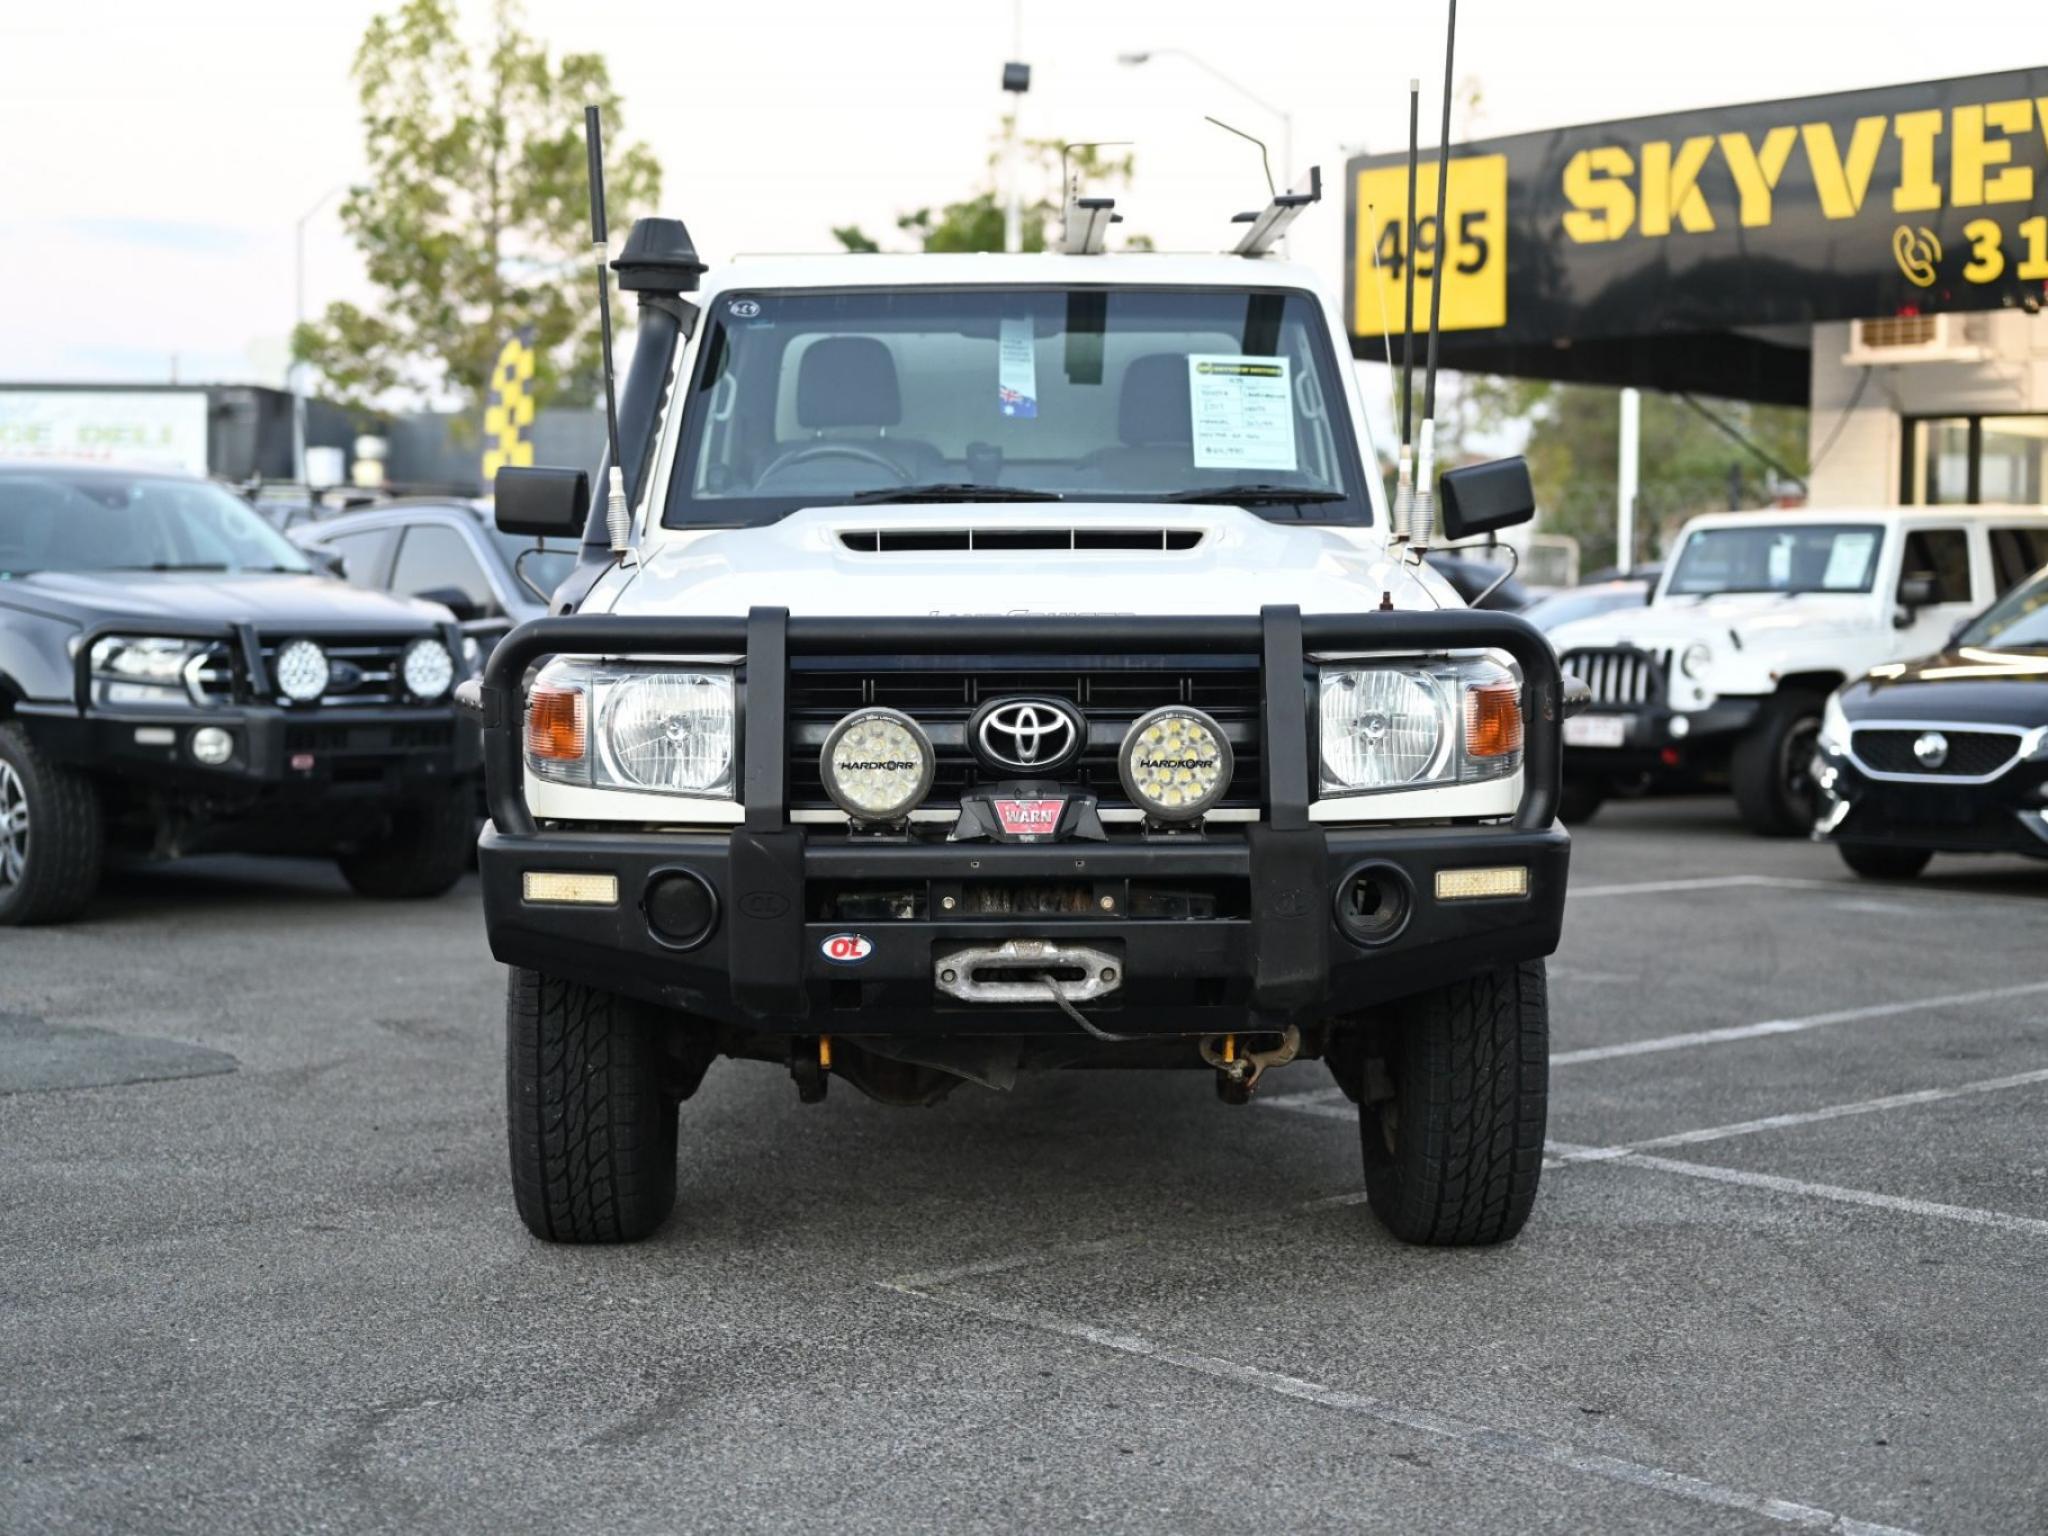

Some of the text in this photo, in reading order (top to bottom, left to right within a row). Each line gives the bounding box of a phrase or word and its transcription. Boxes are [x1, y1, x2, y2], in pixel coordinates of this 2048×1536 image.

[1562, 97, 2048, 243] SKYVIE
[1372, 211, 1489, 281] 495
[1963, 216, 2048, 285] 31
[1006, 809, 1052, 823] WARN
[831, 938, 863, 958] OL
